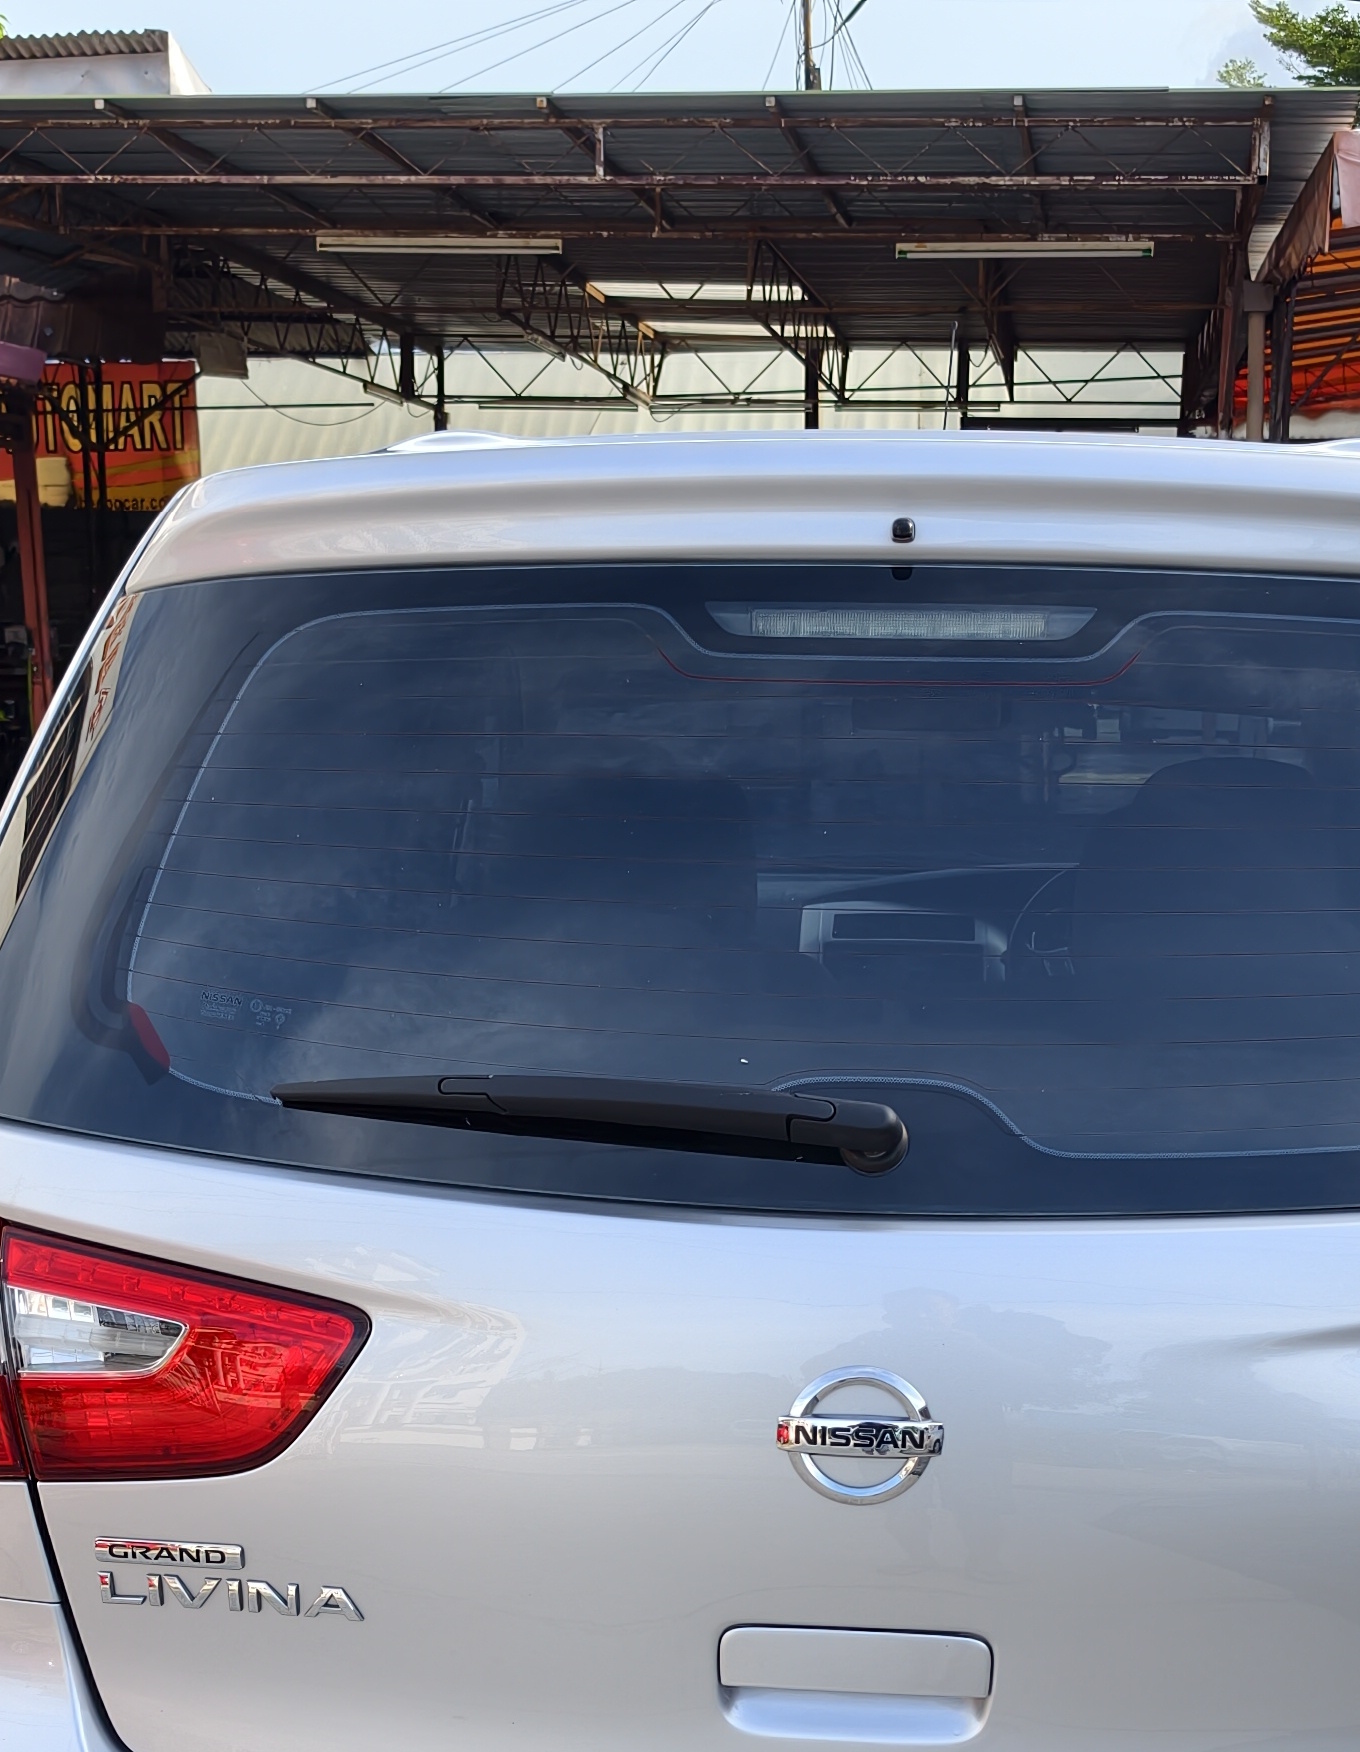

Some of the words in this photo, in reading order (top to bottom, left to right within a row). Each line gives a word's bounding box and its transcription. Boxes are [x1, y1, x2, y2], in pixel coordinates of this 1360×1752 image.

[201, 991, 242, 1006] NISSAN
[794, 1425, 925, 1449] NISSAN
[108, 1543, 226, 1565] GRAND
[97, 1570, 365, 1622] LIVINA
